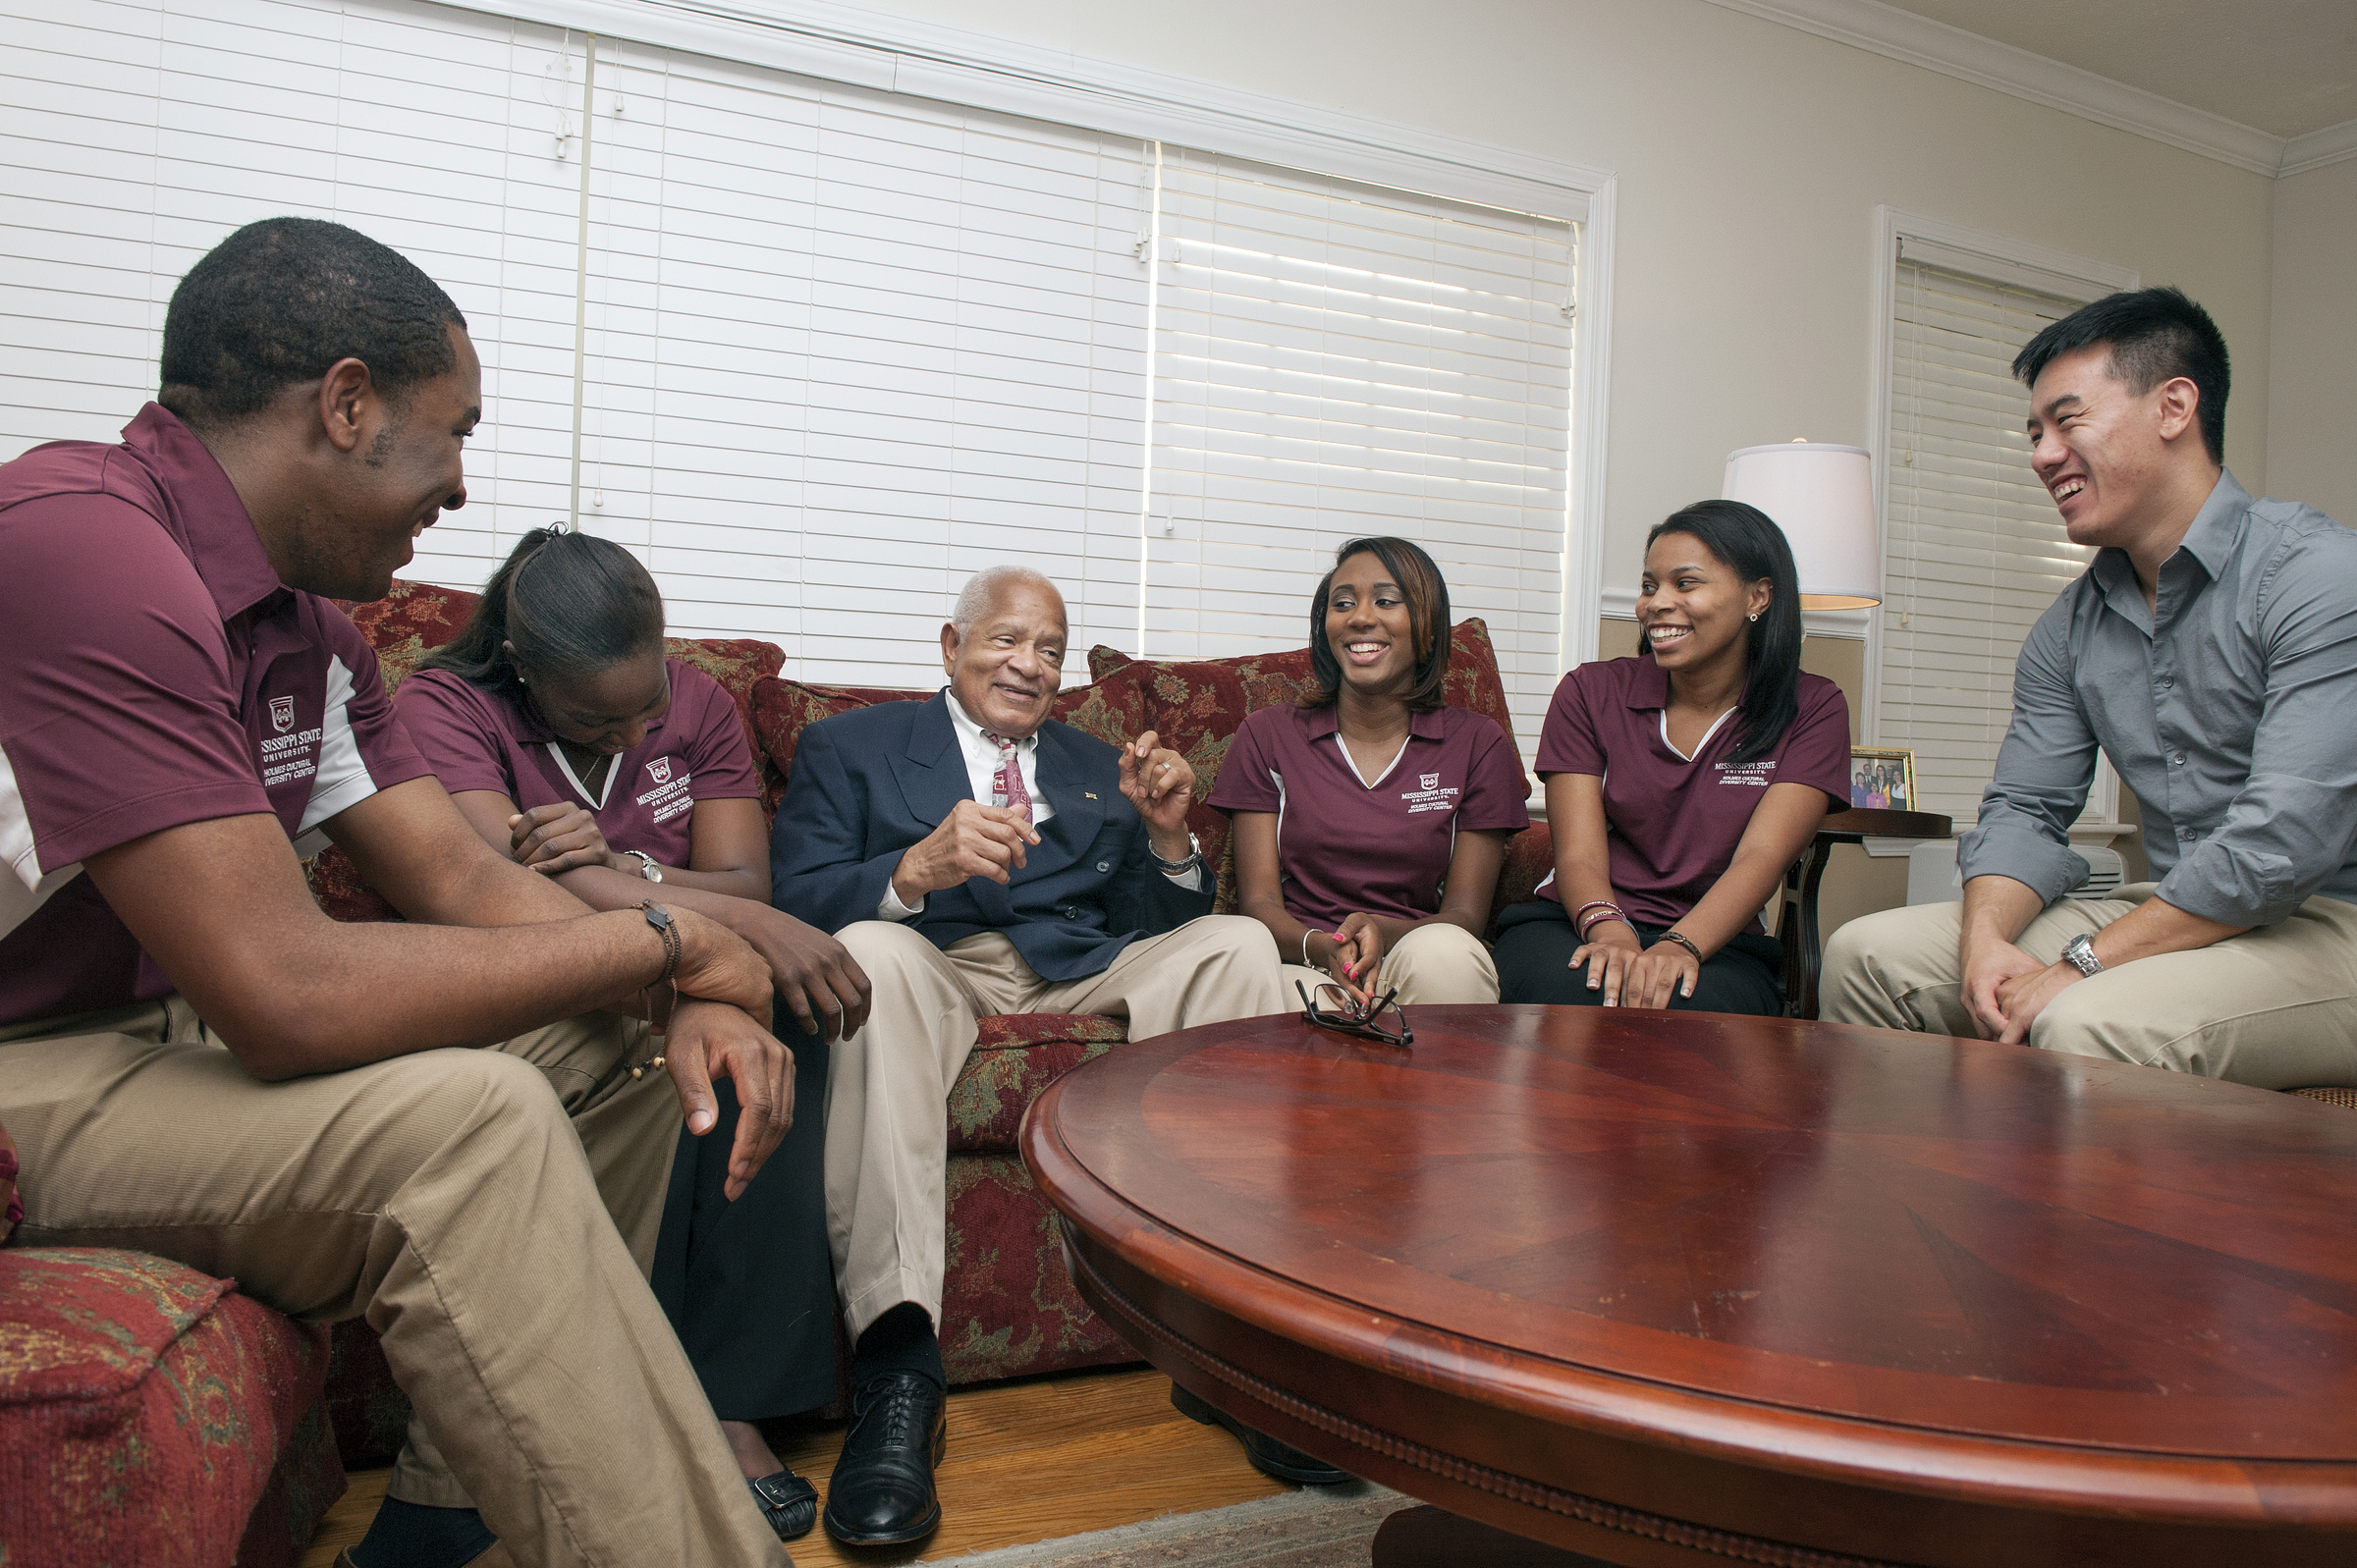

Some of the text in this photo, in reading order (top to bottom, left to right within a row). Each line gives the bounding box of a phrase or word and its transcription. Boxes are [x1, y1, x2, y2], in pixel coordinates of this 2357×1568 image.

[298, 728, 321, 744] STATE
[263, 746, 311, 762] UNIVERSITY
[264, 759, 312, 777] HOLMES CULTURAL
[293, 766, 316, 778] CENTER
[636, 781, 676, 805] MISSISSIPPI
[651, 787, 689, 806] UNIVERSITY
[1402, 790, 1438, 799] MISSISSIPPI
[653, 809, 678, 823] DIVERSITY
[654, 804, 672, 817] HOLMES
